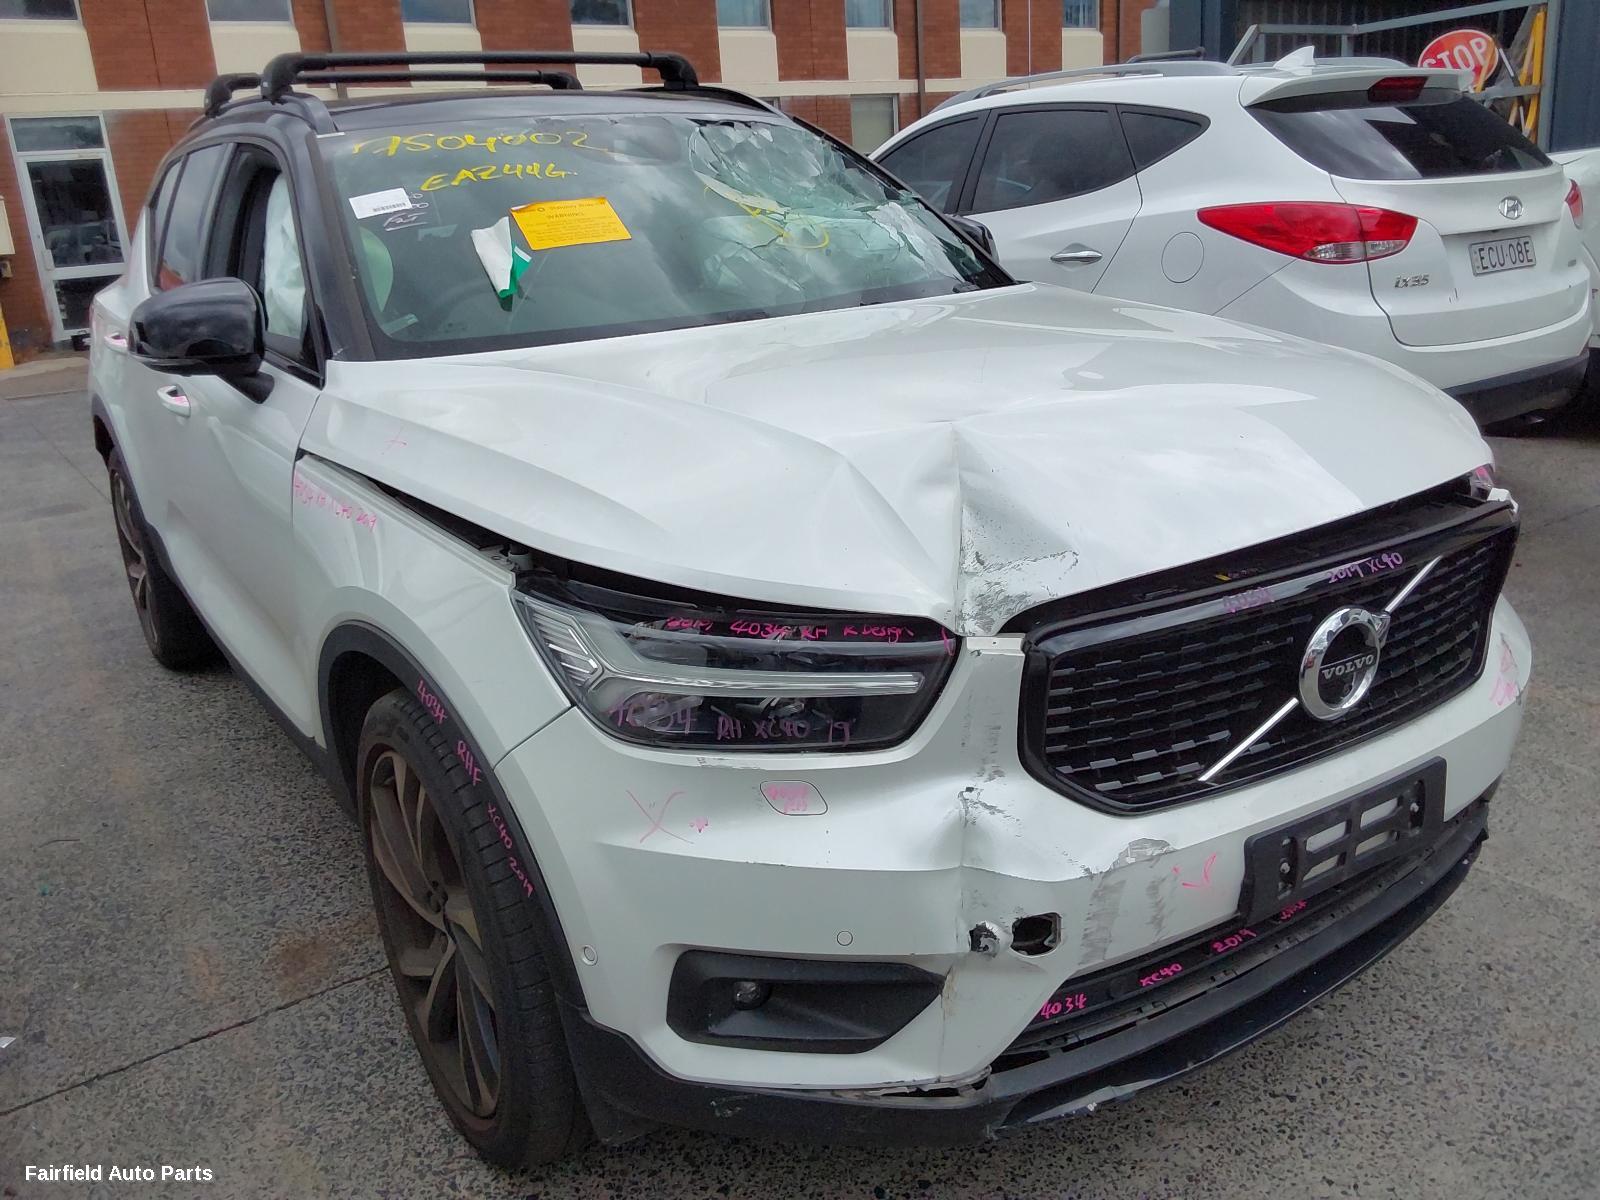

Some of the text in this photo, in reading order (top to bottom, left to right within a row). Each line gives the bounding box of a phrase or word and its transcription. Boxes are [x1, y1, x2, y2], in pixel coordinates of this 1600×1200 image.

[1394, 274, 1430, 289] ix35
[1321, 654, 1375, 680] VOLVO
[1211, 928, 1257, 953] 2019
